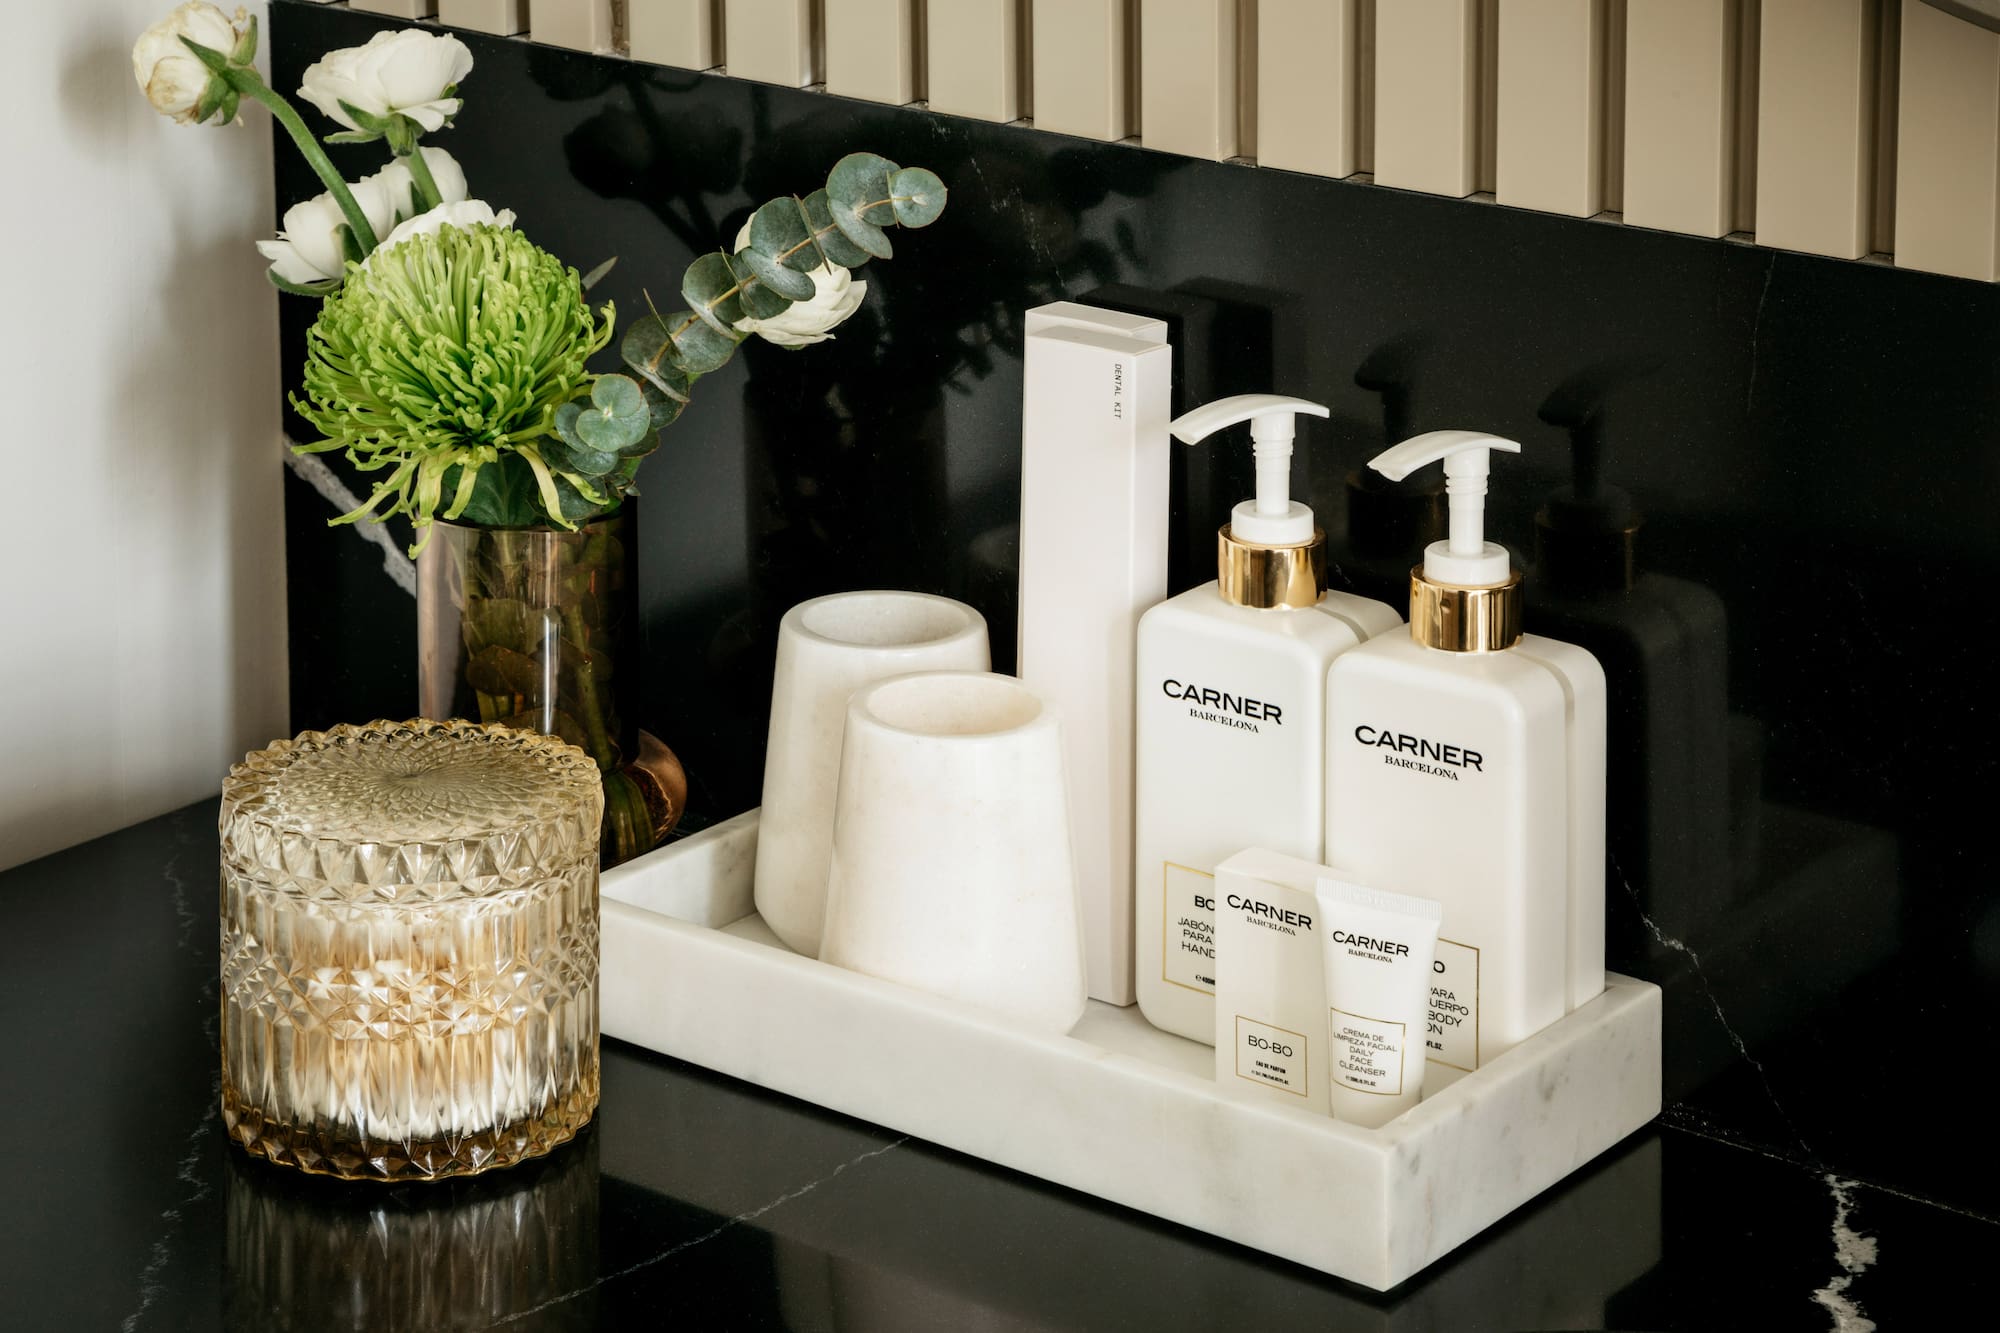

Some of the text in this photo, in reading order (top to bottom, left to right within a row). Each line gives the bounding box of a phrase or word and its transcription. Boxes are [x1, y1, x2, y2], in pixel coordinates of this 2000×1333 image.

[1114, 363, 1122, 419] DENTAL KIT
[1162, 679, 1282, 725] CARNER
[1189, 708, 1260, 733] BARCELONA
[1354, 725, 1483, 772] CARNER
[1384, 755, 1459, 781] BARCELONA
[1226, 894, 1312, 930] CARNER
[1246, 916, 1297, 936] BARCELONA
[1183, 929, 1213, 945] PARA
[1332, 931, 1409, 957] CARNER
[1347, 948, 1393, 963] BARCELONA
[1430, 987, 1456, 1001] ARA
[1343, 1027, 1384, 1042] CREMA DE
[1248, 1034, 1293, 1057] BO-BO
[1349, 1046, 1374, 1057] DAILY
[1367, 1041, 1398, 1052] FACIAL
[1339, 1060, 1386, 1077] CLEANSER
[1350, 1055, 1373, 1067] FACE
